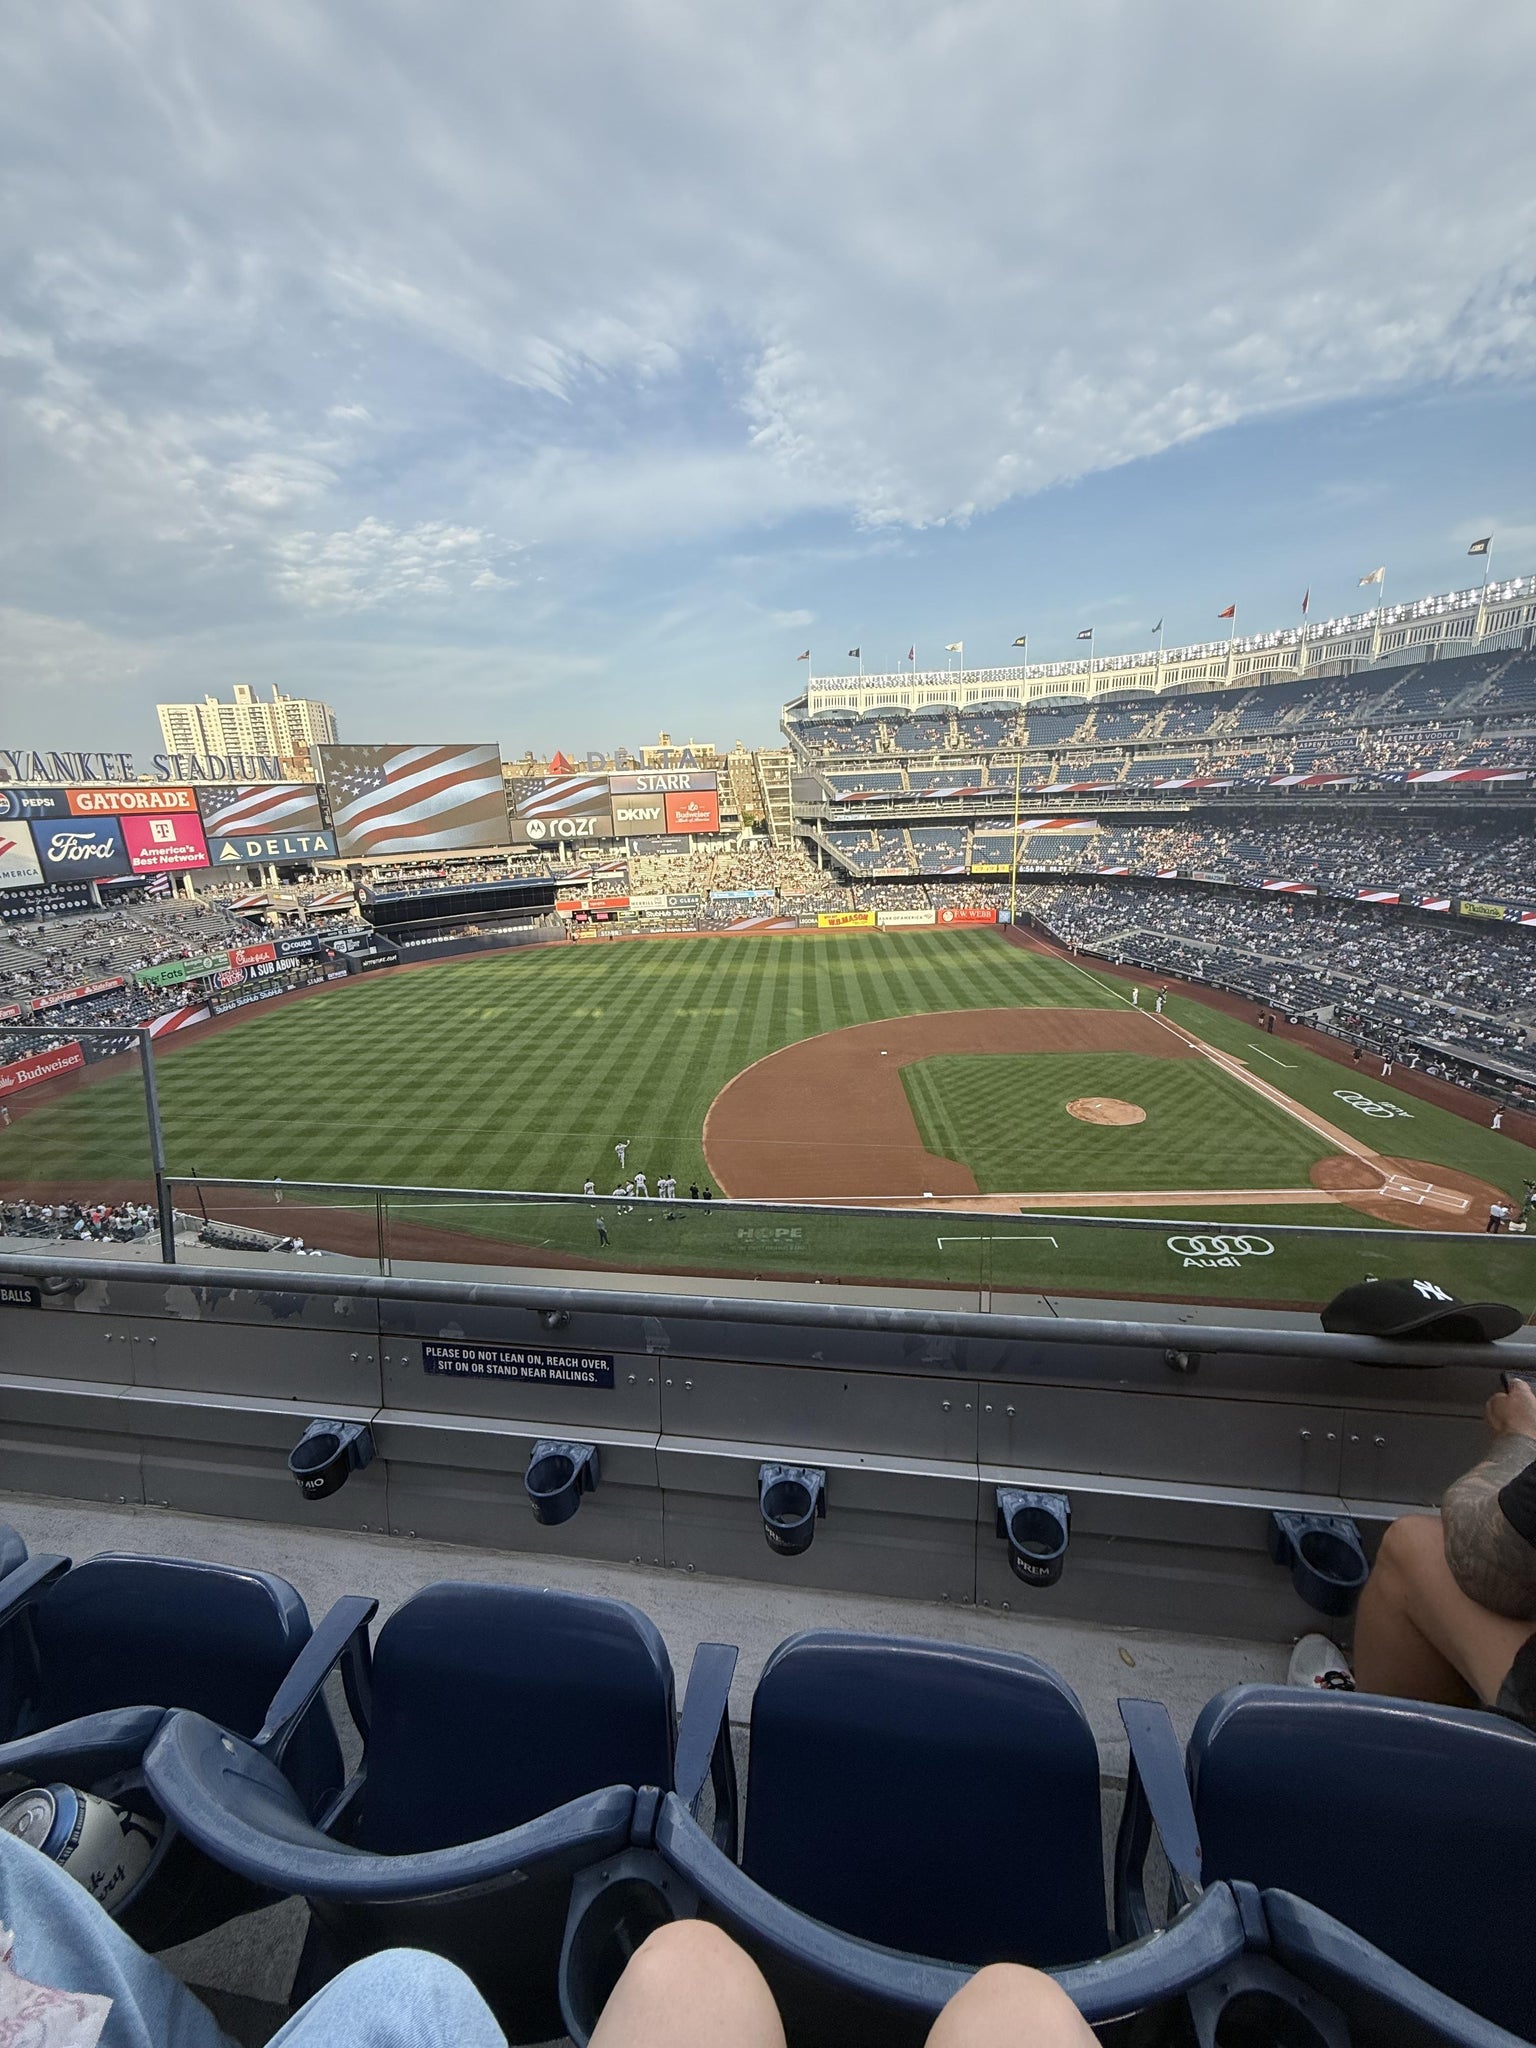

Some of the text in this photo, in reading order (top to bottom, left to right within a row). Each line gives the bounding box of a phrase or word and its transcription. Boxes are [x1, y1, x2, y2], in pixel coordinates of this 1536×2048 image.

[1425, 732, 1455, 740] VODKA
[1, 750, 283, 782] YANKEE STADIUM
[587, 748, 698, 772] DELTA
[637, 774, 691, 791] STARR
[21, 798, 55, 807] PEPSI
[76, 791, 191, 811] GATORADE
[616, 807, 661, 821] DKNY
[550, 818, 598, 837] razr
[48, 832, 115, 862] Ford
[140, 845, 195, 857] America's
[246, 836, 329, 857] DELTA
[133, 853, 205, 866] Best Network
[1019, 865, 1035, 873] 6:56
[1035, 865, 1046, 873] PM
[969, 910, 992, 918] WEBB
[290, 939, 312, 950] coupa
[160, 970, 183, 981] Eats
[250, 966, 257, 979] A
[257, 962, 275, 976] SUB
[215, 988, 284, 1015] StubHub StubHub StubHub
[16, 1053, 81, 1084] Budweiser
[1183, 1256, 1242, 1268] Audi
[0, 1288, 32, 1303] BALLS
[425, 1346, 611, 1372] PLEASE DO NOT LEAN ON, REACH OVER,
[438, 1360, 598, 1383] SIT ON OR STAND NEAR RAILINGS.
